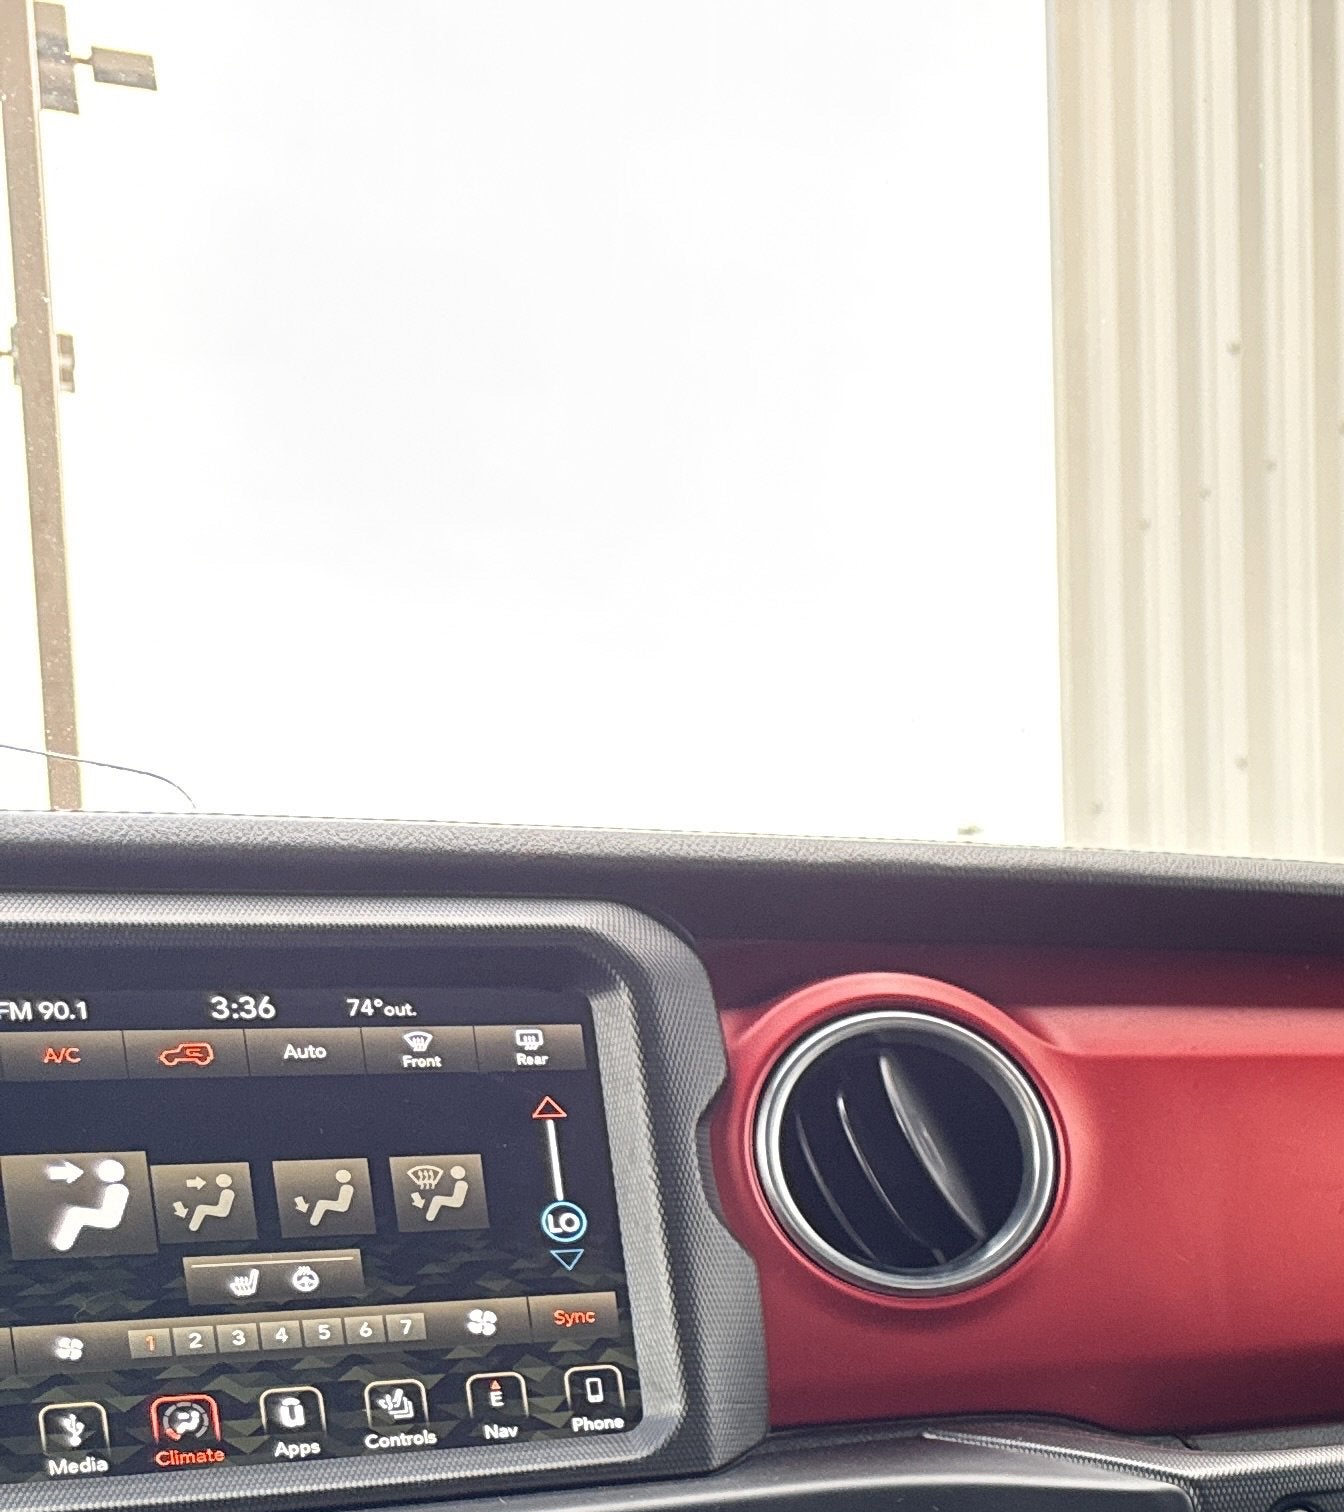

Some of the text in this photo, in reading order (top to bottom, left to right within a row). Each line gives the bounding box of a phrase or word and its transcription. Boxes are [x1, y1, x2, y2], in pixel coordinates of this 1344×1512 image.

[0, 1001, 87, 1021] FM 90.1
[210, 995, 276, 1019] 3:36
[44, 1047, 81, 1064] A/C
[283, 1043, 327, 1059] Auto
[516, 1052, 549, 1066] Rear
[402, 1055, 442, 1068] Front
[547, 1212, 580, 1233] LO
[553, 1309, 597, 1327] Sync
[146, 1319, 412, 1351] 1 2 3 4 5 6 7
[490, 1391, 504, 1407] E
[484, 1424, 519, 1440] Nav
[572, 1416, 625, 1432] Phone
[274, 1438, 320, 1458] Apps
[365, 1430, 438, 1450] Controls
[49, 1456, 108, 1476] Media
[155, 1449, 225, 1468] Climate
